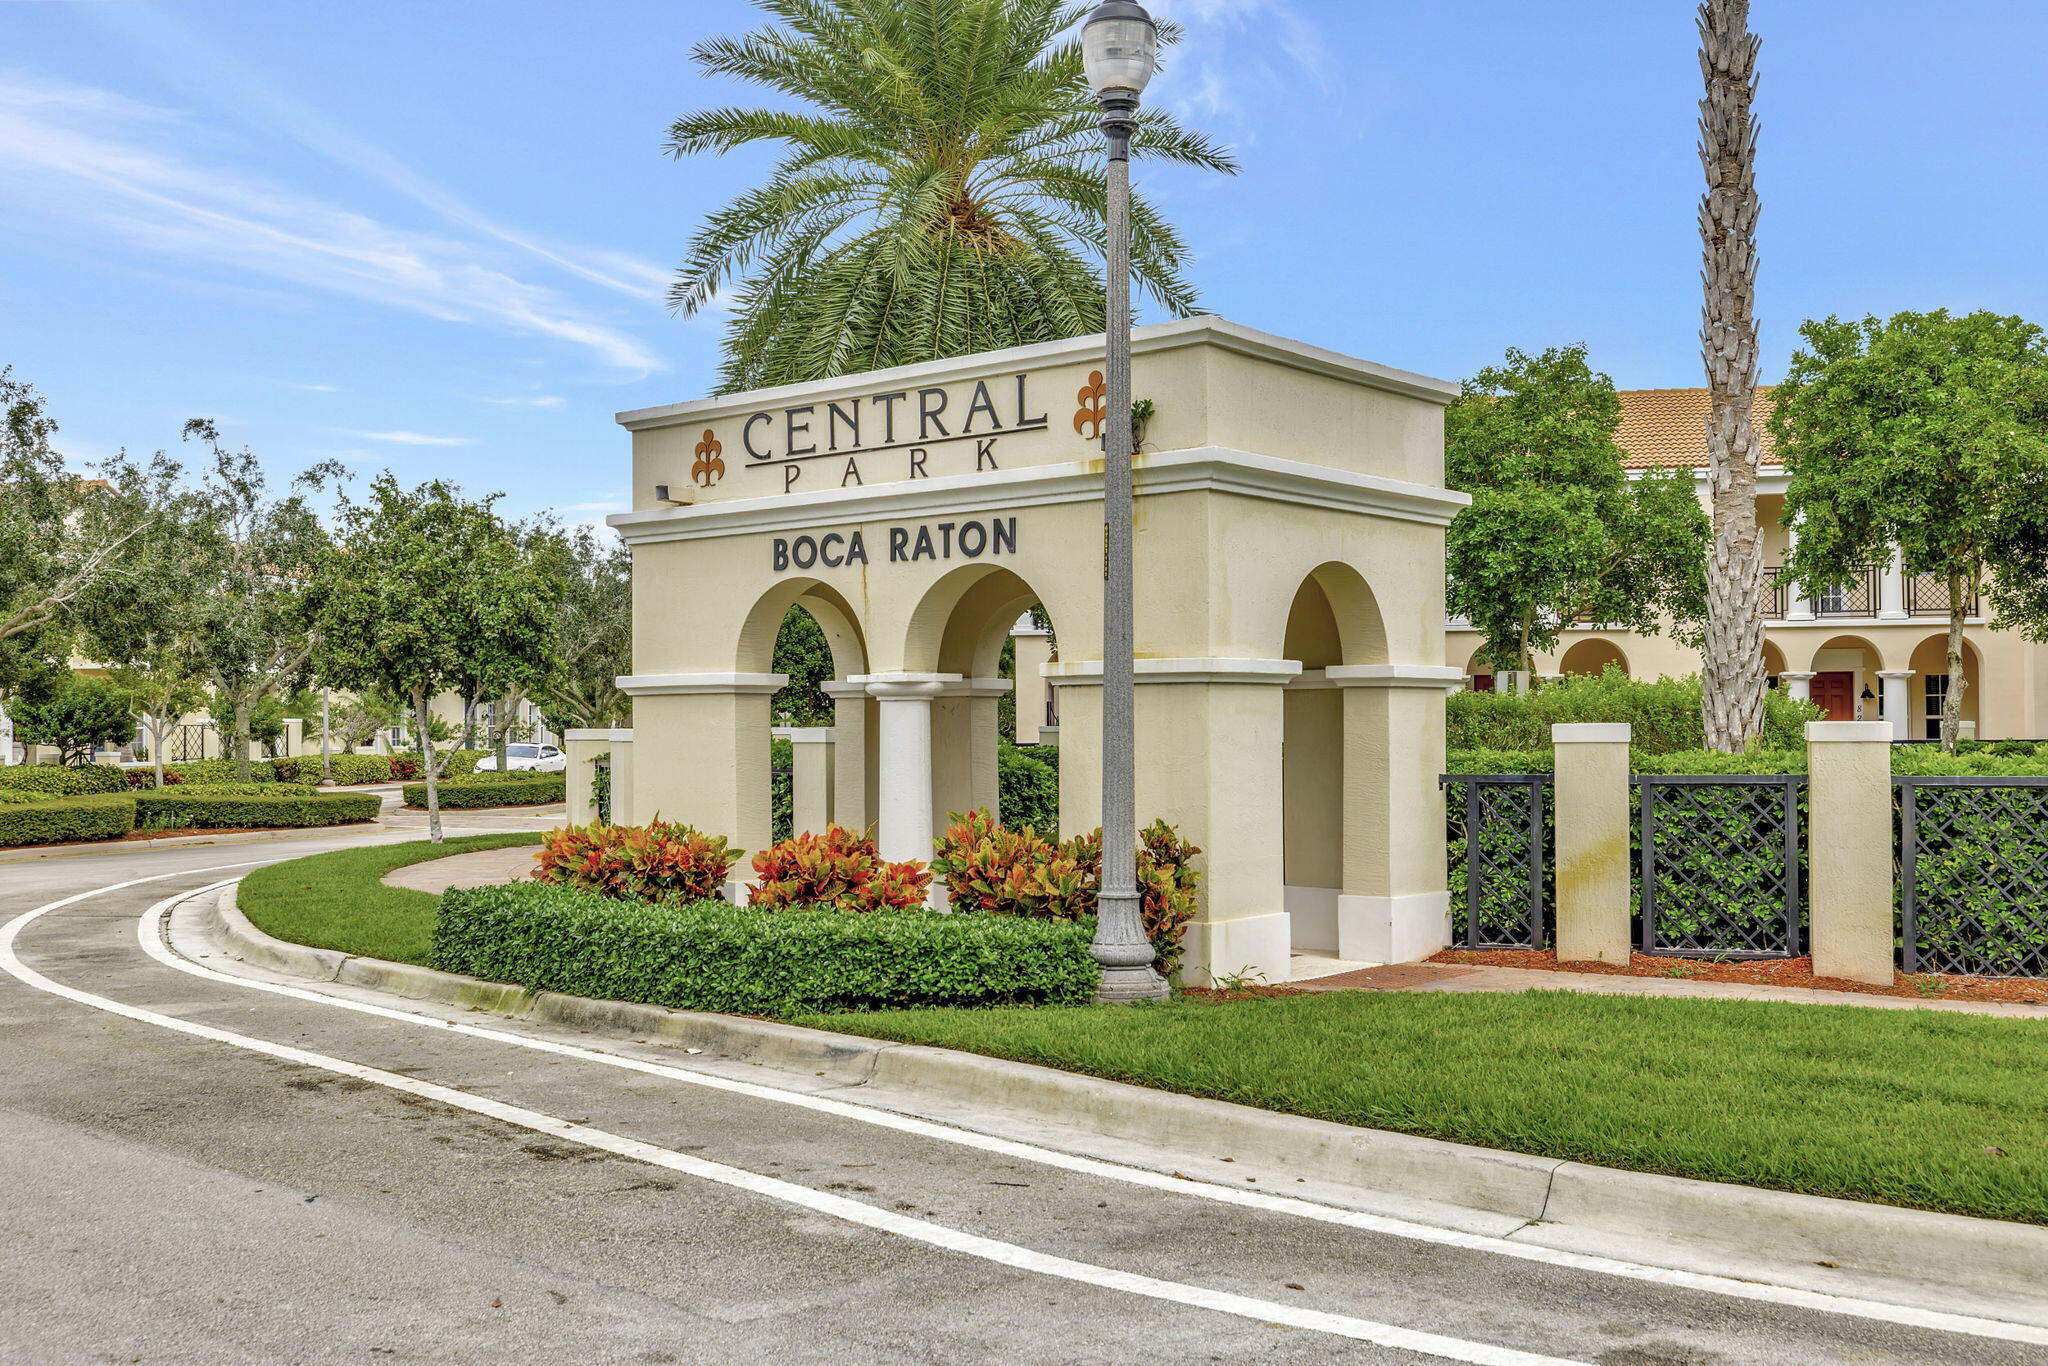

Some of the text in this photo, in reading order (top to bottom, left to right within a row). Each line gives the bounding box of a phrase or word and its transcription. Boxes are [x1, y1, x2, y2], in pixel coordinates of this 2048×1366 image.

[743, 374, 1048, 460] CENTRAL
[784, 438, 998, 494] PARK
[773, 517, 1017, 571] BOCA RATON
